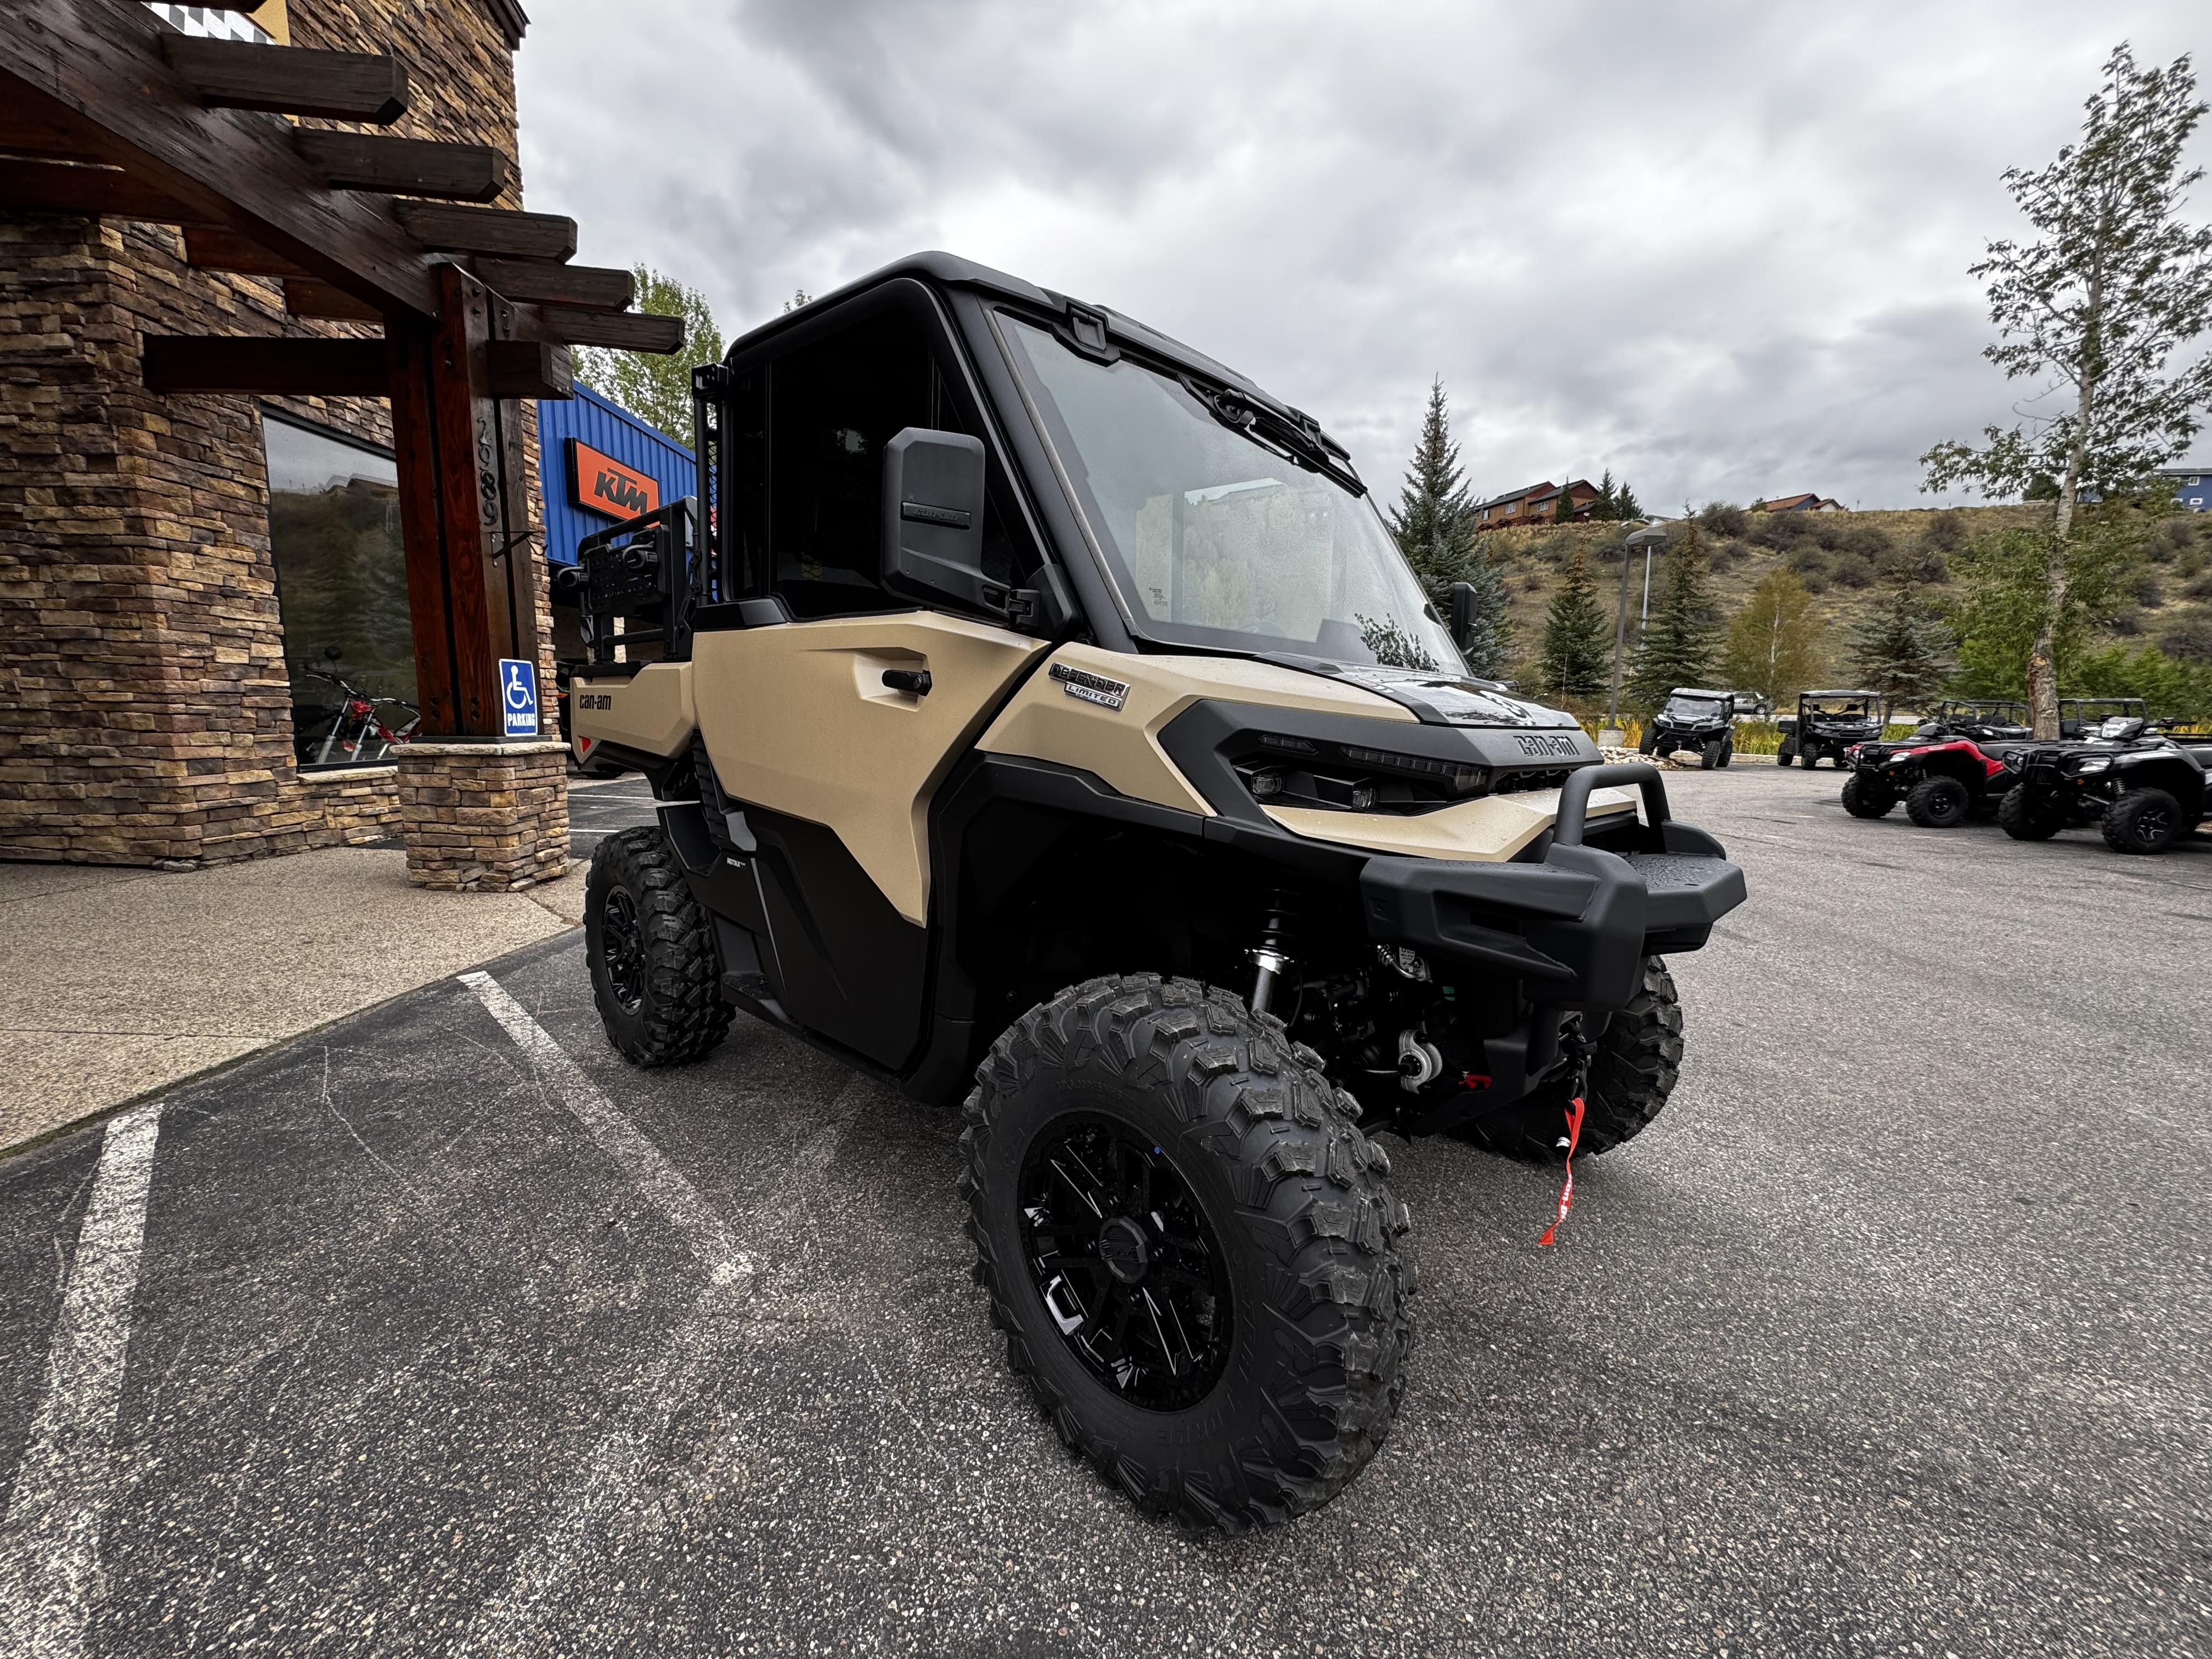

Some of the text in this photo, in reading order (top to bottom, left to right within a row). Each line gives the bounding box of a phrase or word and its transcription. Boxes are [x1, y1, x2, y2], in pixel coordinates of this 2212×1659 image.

[594, 467, 648, 515] KTM
[1052, 665, 1126, 696] DEFENDER
[579, 694, 612, 710] can-am
[1068, 685, 1116, 705] LIMITED
[507, 713, 535, 727] PARKING
[1513, 736, 1581, 757] can-am
[727, 857, 740, 868] ROTAX
